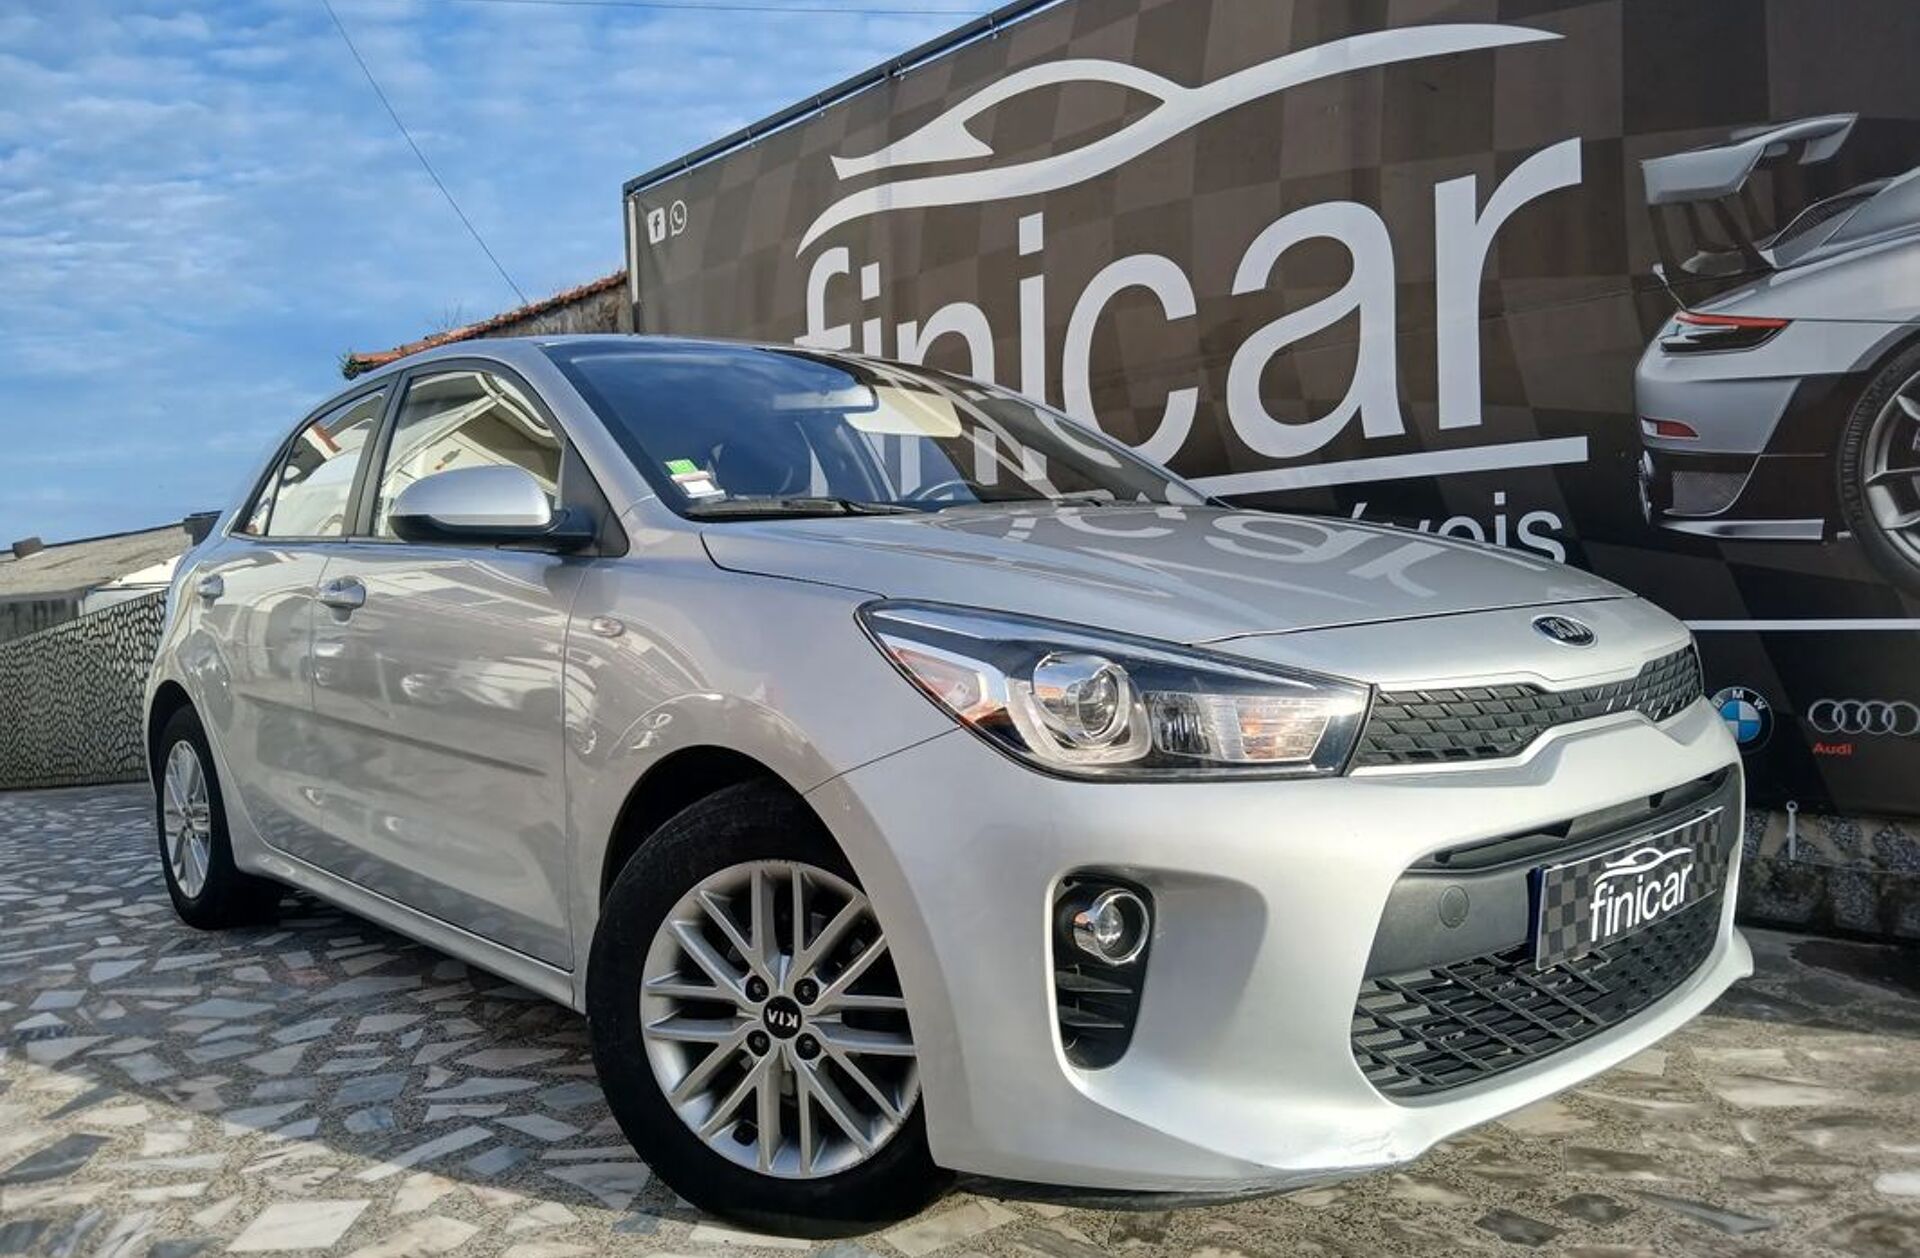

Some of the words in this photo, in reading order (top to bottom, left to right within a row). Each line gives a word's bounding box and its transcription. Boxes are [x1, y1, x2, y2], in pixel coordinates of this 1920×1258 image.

[794, 137, 1584, 497] finicar
[1812, 742, 1853, 756] Audi
[1590, 863, 1694, 942] finicar
[767, 1008, 798, 1028] KIA
